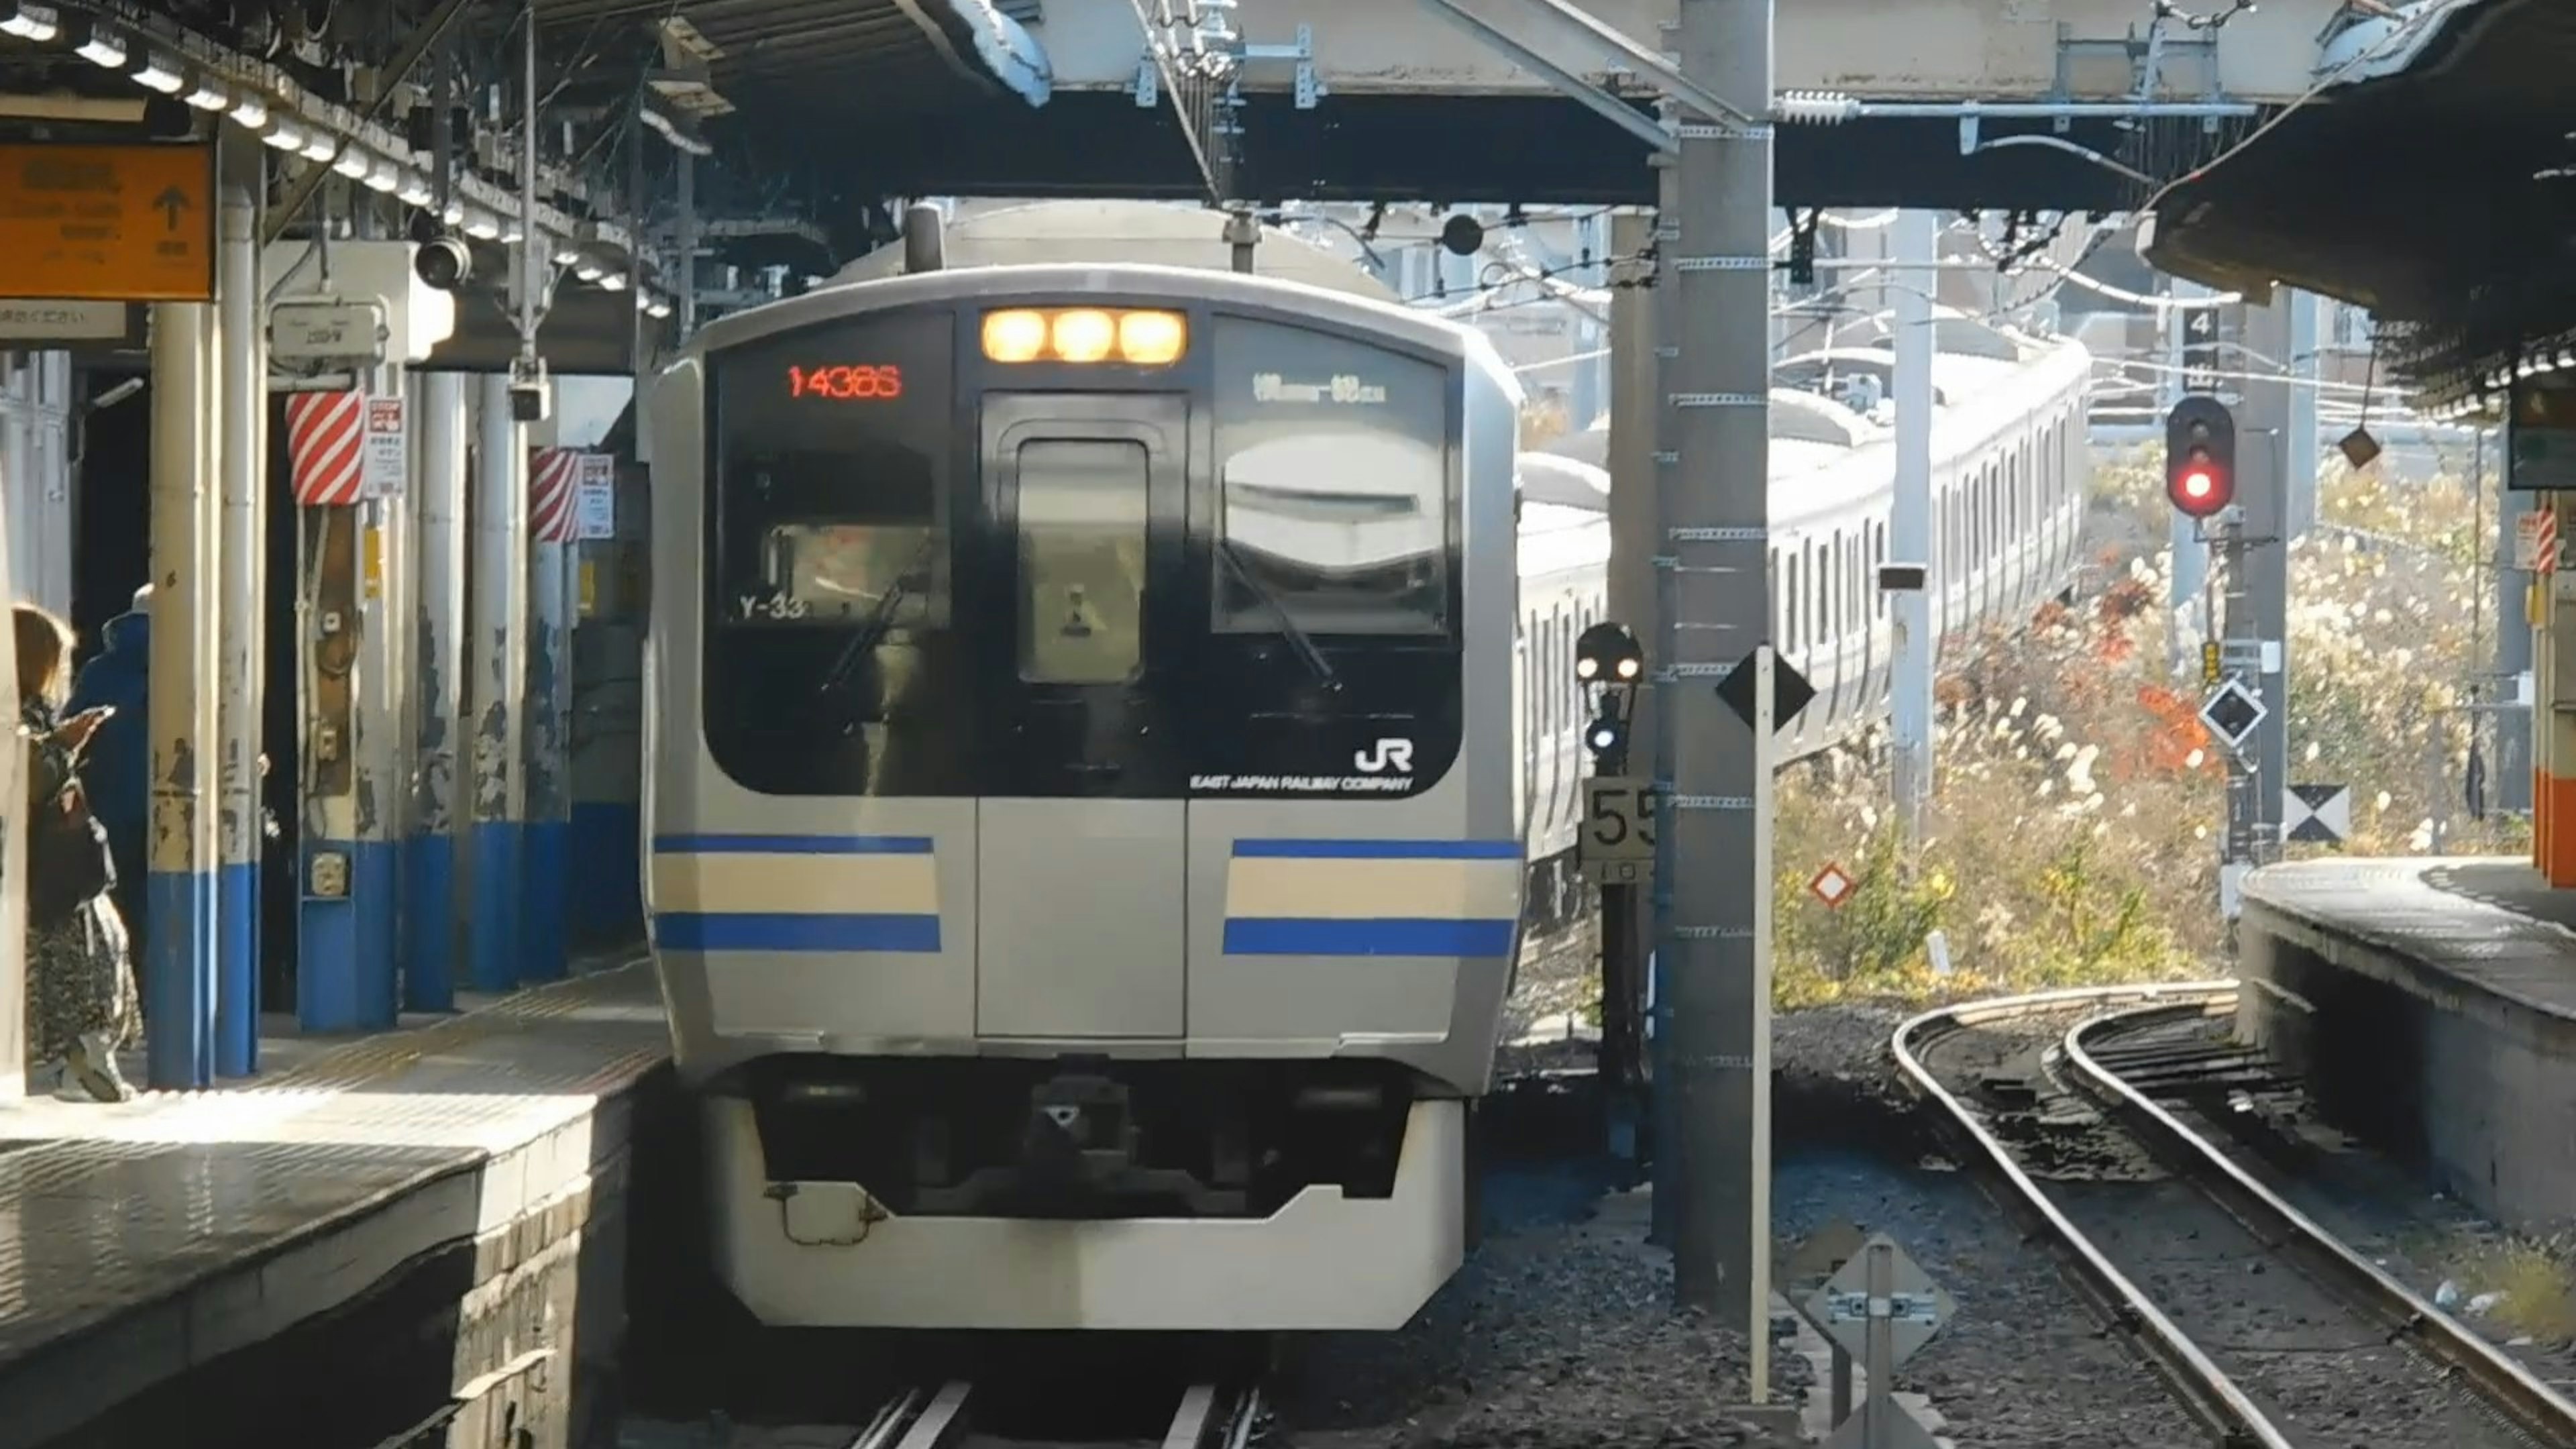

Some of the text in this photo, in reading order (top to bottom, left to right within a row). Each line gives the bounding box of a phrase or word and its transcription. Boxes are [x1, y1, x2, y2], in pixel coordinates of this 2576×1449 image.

[2191, 312, 2210, 334] 4
[1354, 738, 1413, 772] JR
[1190, 775, 1413, 790] EAST JAPAN RAILWAY COMPANY
